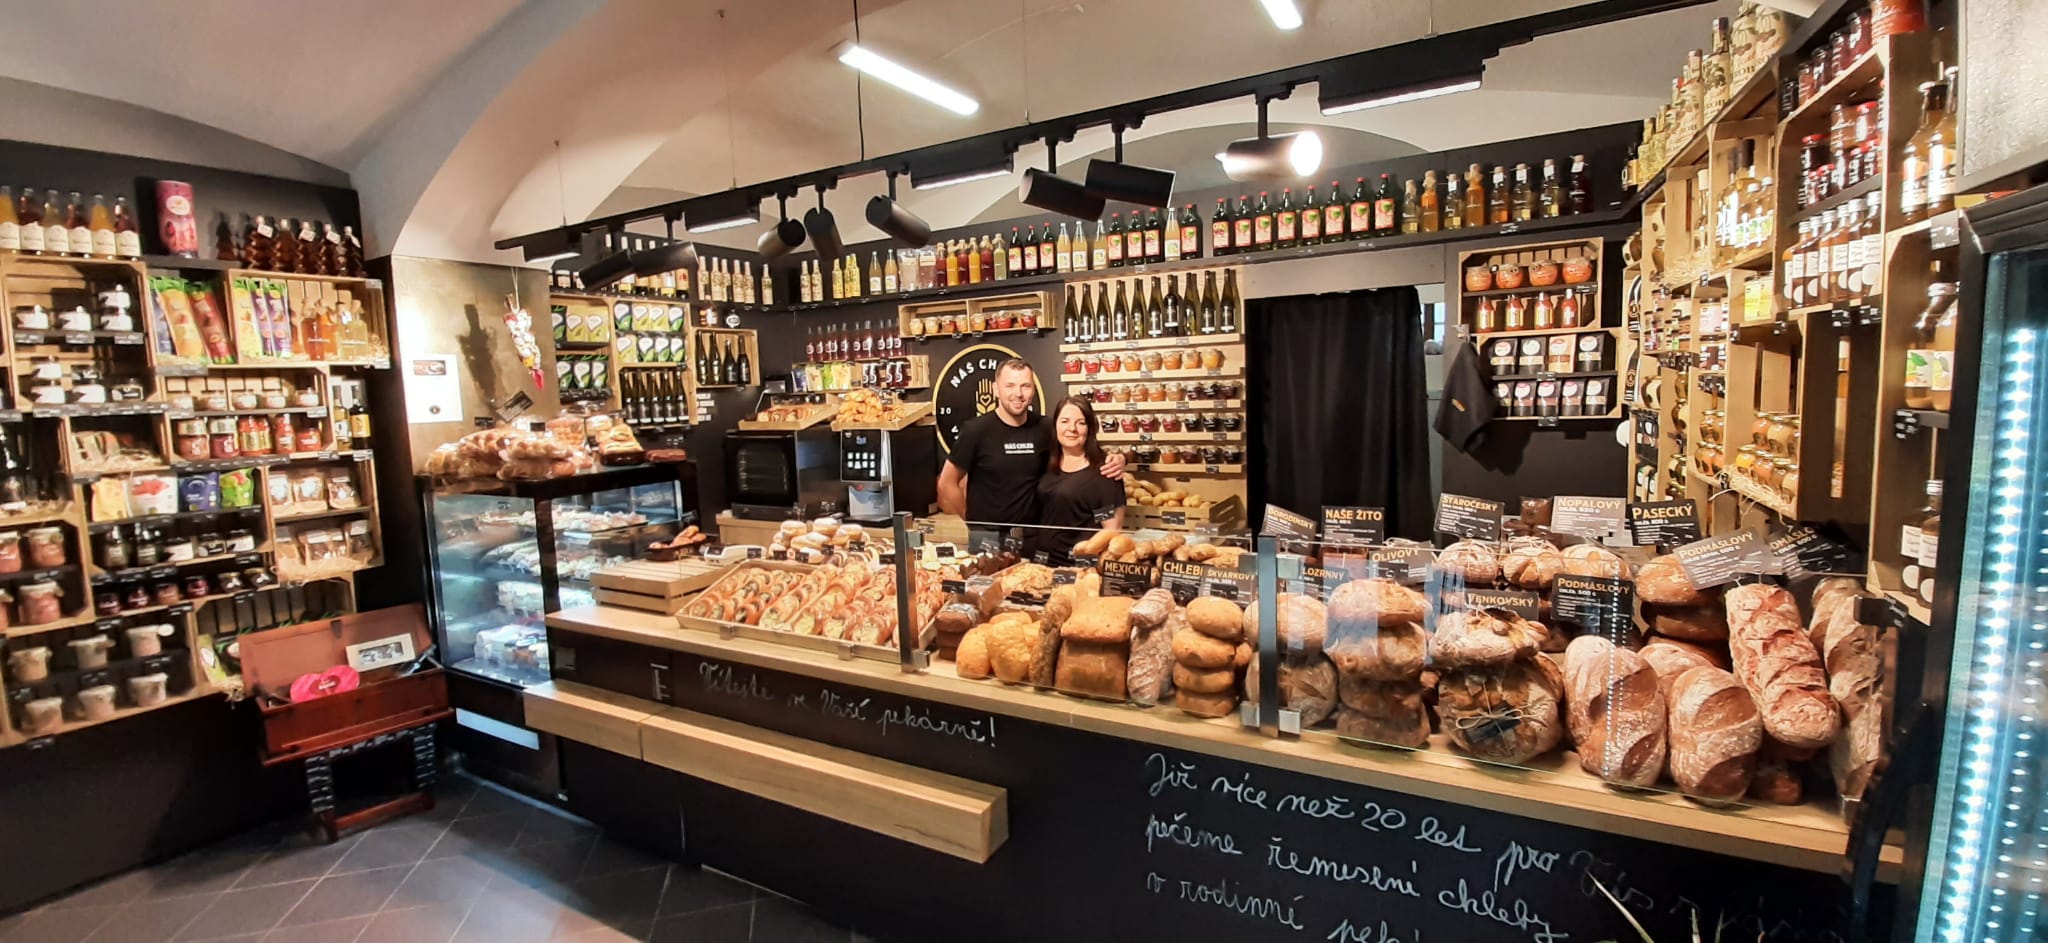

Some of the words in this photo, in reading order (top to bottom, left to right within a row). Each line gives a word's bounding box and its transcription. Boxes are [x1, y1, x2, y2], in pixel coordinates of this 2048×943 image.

[1324, 508, 1354, 520] NAŠE
[1356, 508, 1382, 521] ŽITO
[1631, 503, 1693, 520] PASECKÝ
[876, 704, 997, 748] pekárně!
[1144, 752, 1198, 797] Již
[1210, 771, 1268, 810] více
[1276, 794, 1356, 819] než
[1360, 802, 1407, 833] 20
[1414, 816, 1483, 853] let
[1493, 840, 1561, 894] pro
[1144, 813, 1243, 856] pečeme
[1438, 878, 1569, 943] chleby
[1179, 877, 1305, 931] rodinné
